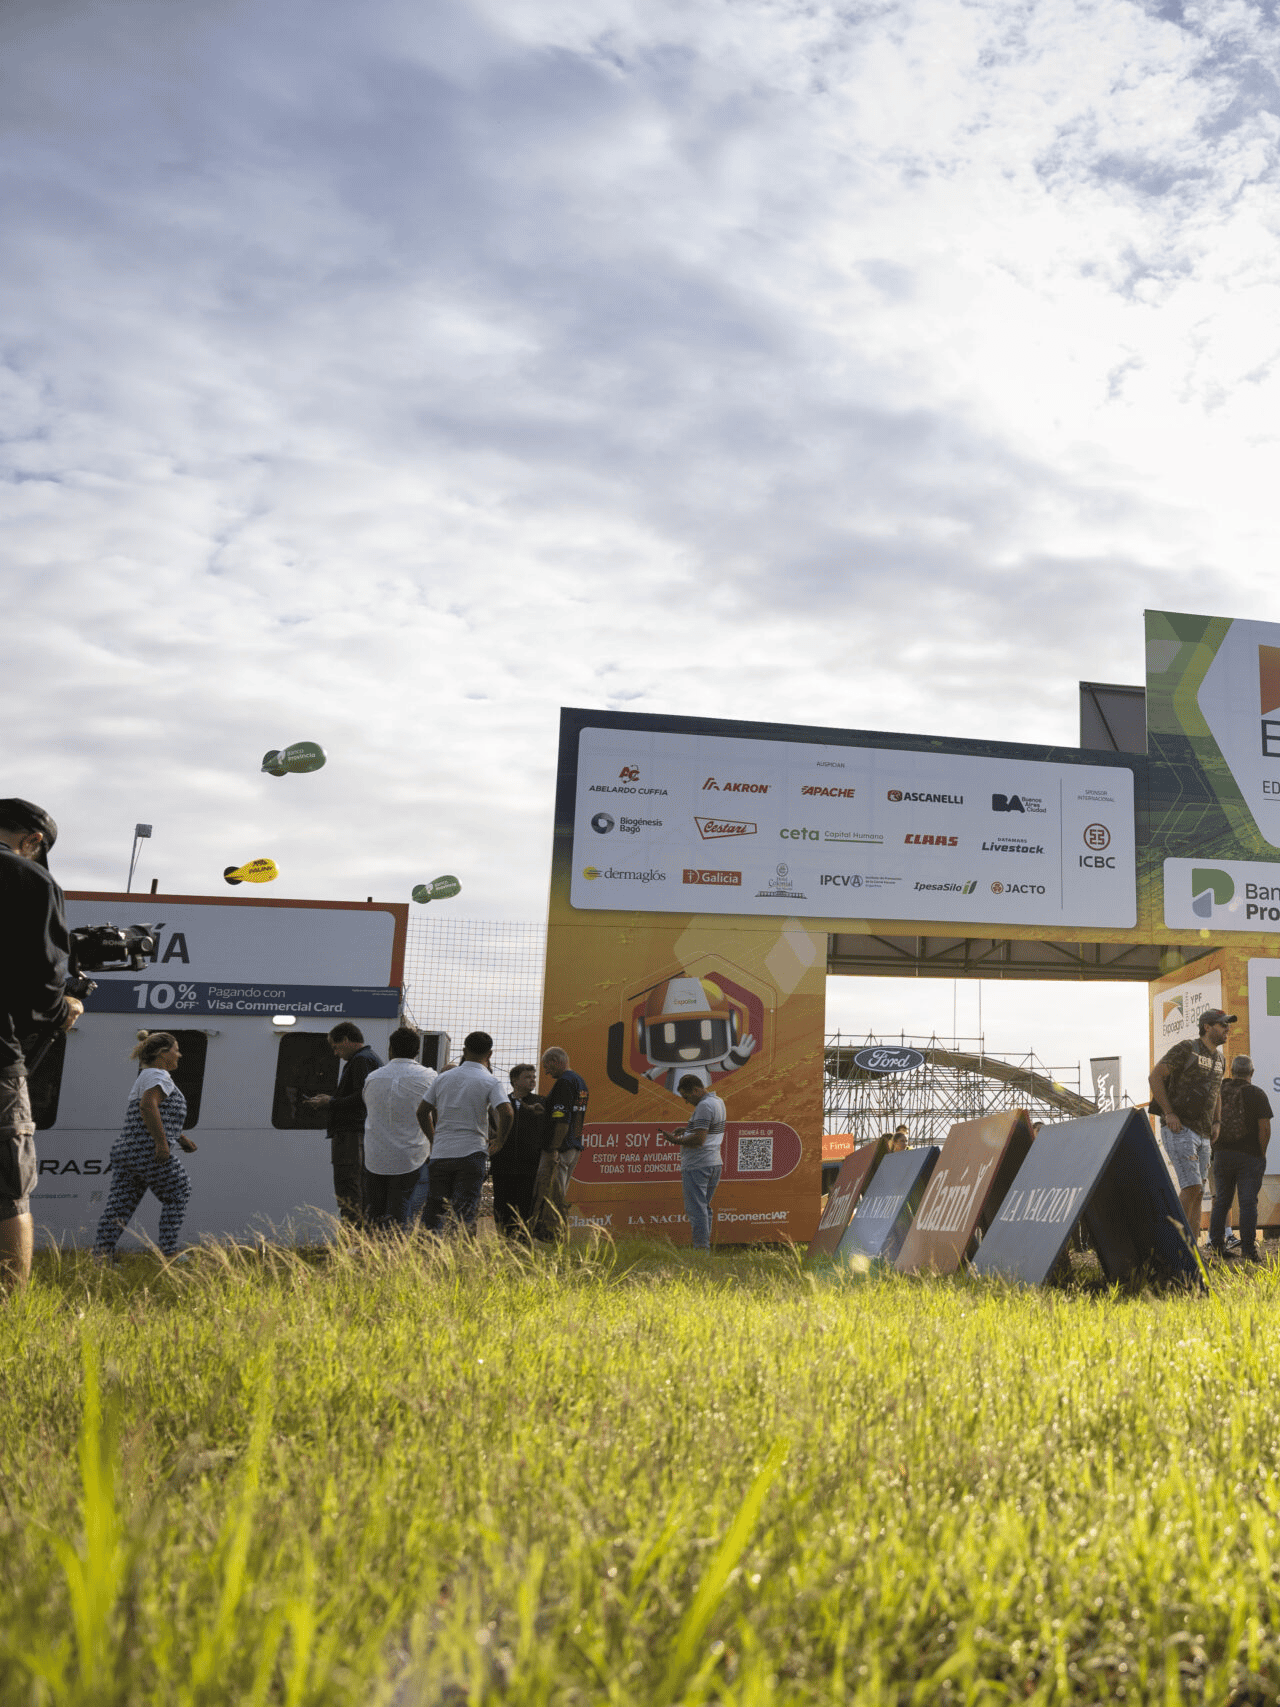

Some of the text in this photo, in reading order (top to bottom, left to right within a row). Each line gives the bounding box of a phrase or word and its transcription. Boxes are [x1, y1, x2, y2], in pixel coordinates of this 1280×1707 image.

[589, 785, 668, 796] ABELARDO CUFFIA
[723, 782, 768, 794] AKRON
[803, 786, 855, 798] APACHE
[903, 792, 964, 805] ASCANELLI
[991, 793, 1026, 813] BA
[620, 816, 663, 827] Biogénesis
[703, 820, 748, 834] Cestari
[620, 824, 641, 834] Bagó
[779, 827, 884, 841] ceta Capital Humano
[904, 833, 959, 847] CLAAS
[981, 842, 1045, 854] Livestock
[1079, 855, 1116, 869] ICBC
[604, 868, 666, 884] dermaglós
[701, 873, 739, 884] Galicia
[914, 881, 962, 893] IpesaSilo
[1005, 884, 1046, 895] JACTO
[208, 986, 286, 999] Pagando con
[206, 1000, 346, 1013] Visa Commercial Card.
[868, 1050, 911, 1067] Ford
[581, 1133, 619, 1147] HOLA!
[625, 1133, 651, 1147] SOY
[830, 1142, 851, 1150] Fima
[593, 1152, 681, 1162] ESTOY PARA AYUDARTE
[600, 1163, 681, 1173] TODAS TUS CONSULTA
[916, 1166, 971, 1232] Clarín
[1000, 1187, 1083, 1223] LA NACION
[628, 1216, 645, 1224] LA
[650, 1214, 690, 1224] NACIO
